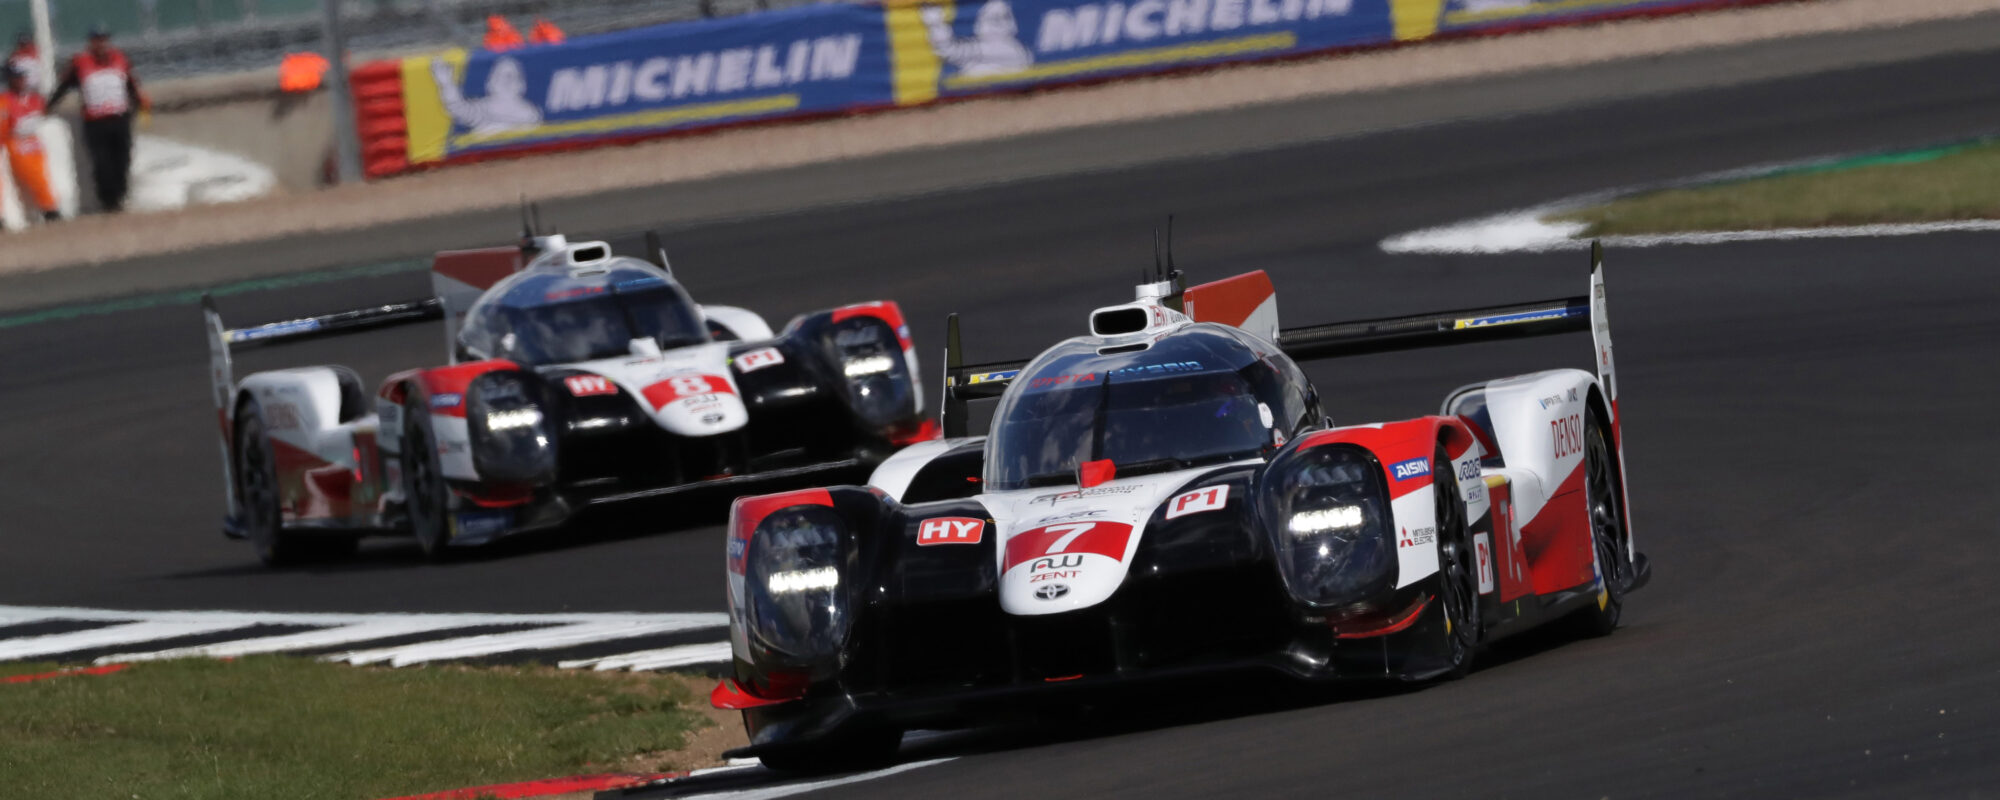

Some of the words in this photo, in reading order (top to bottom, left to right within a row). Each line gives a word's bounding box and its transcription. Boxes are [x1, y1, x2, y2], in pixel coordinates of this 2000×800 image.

[546, 34, 862, 113] MICHELIN
[746, 350, 774, 369] P1
[573, 376, 609, 393] HY
[671, 376, 713, 397] 8
[1551, 413, 1582, 459] DENSO
[1397, 459, 1429, 478] AISIN
[1176, 488, 1219, 512] P1
[922, 520, 977, 539] HY
[1044, 522, 1097, 555] 7
[1412, 526, 1435, 537] MITSUBISH
[1477, 542, 1493, 584] P1
[1030, 570, 1081, 583] ZENT
